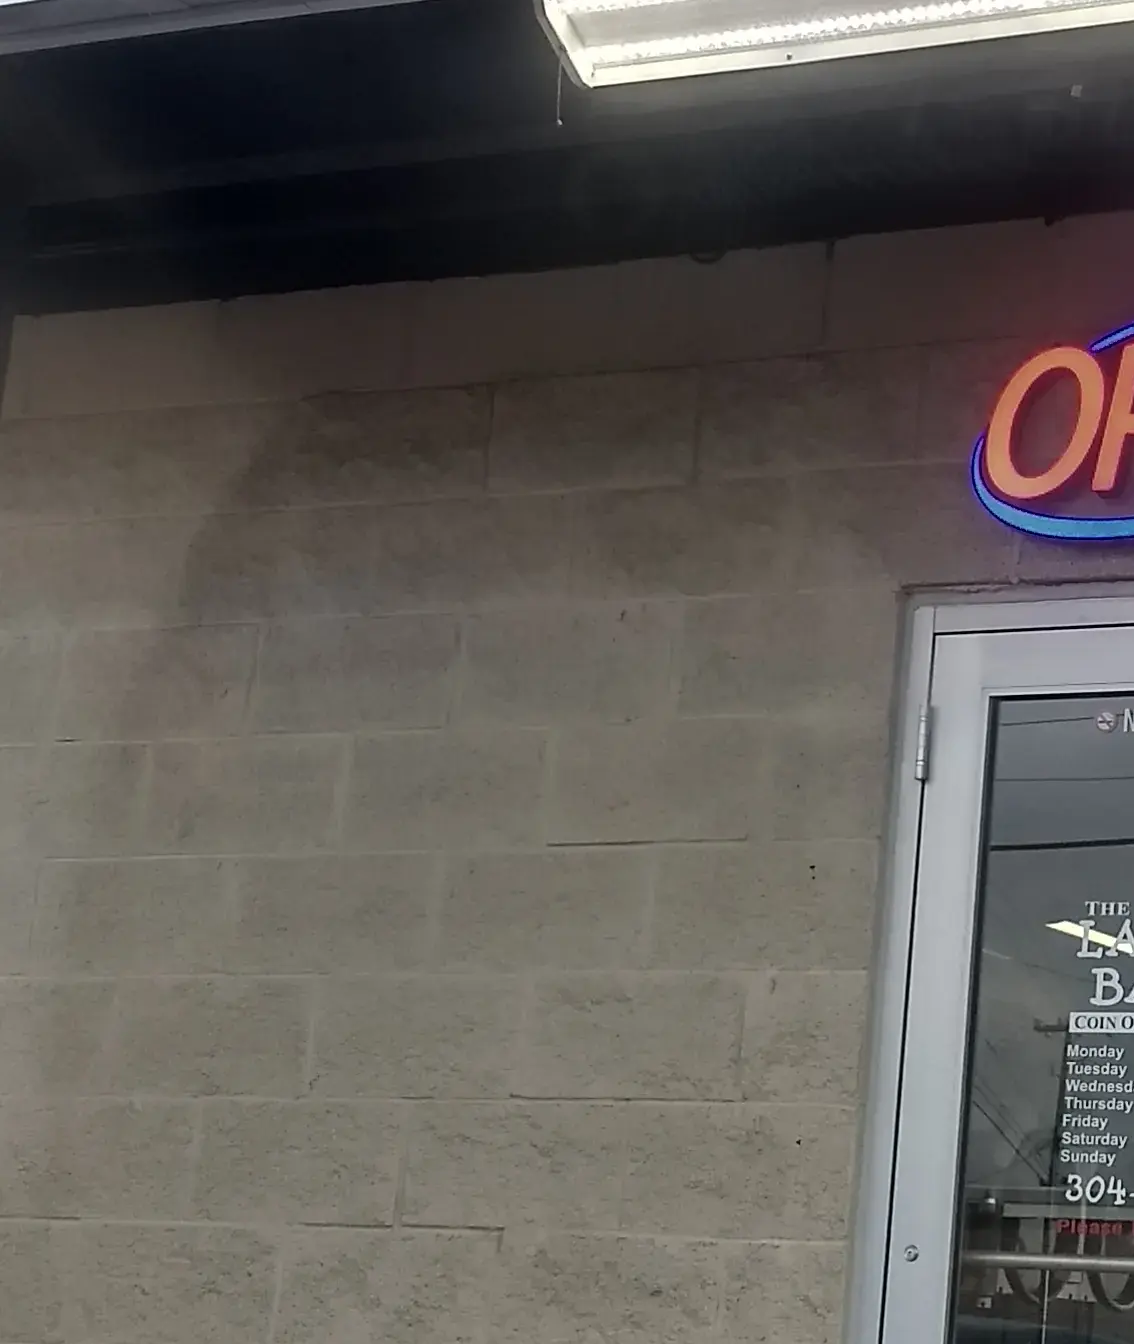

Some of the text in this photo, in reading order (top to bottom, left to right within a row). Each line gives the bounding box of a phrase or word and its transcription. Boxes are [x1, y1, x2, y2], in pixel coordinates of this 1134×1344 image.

[1085, 901, 1130, 916] THE
[1074, 1015, 1117, 1030] COIN
[1066, 1045, 1125, 1060] Monday
[1066, 1062, 1128, 1078] Tuesday
[1064, 1097, 1134, 1113] Thursday
[1062, 1114, 1109, 1130] Friday
[1061, 1132, 1128, 1147] Saturday
[1060, 1150, 1116, 1166] Sunday
